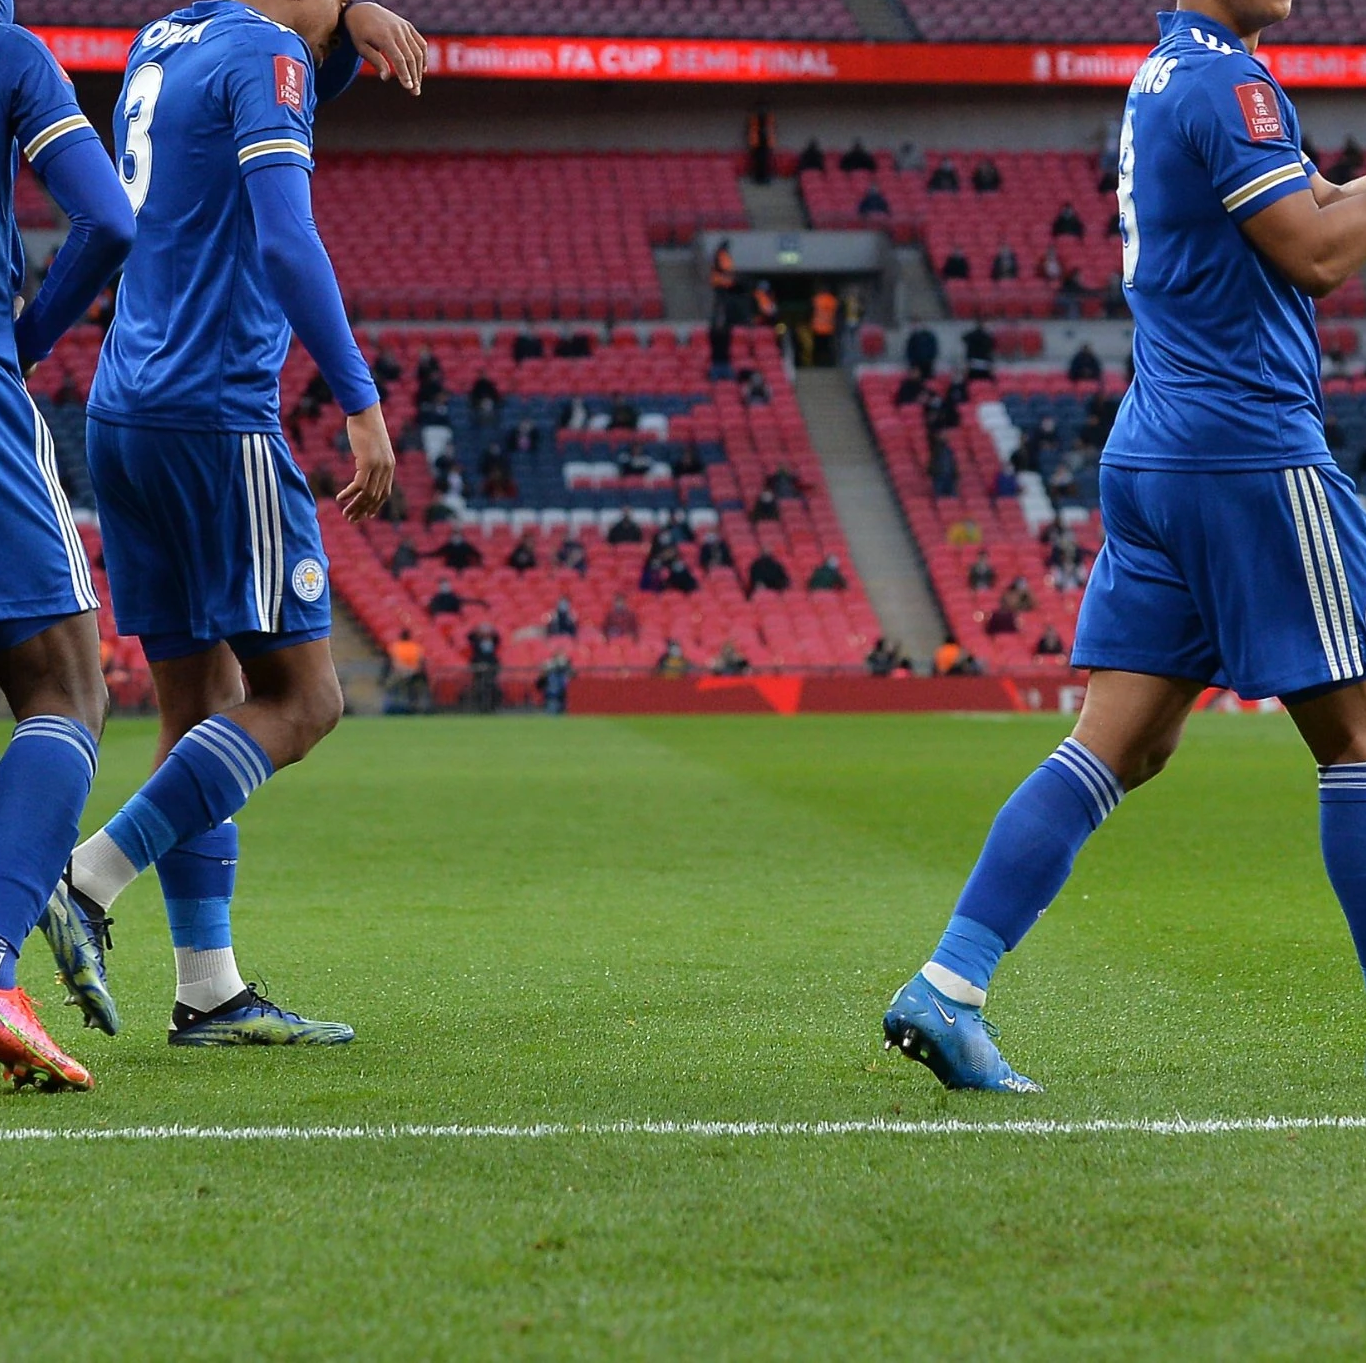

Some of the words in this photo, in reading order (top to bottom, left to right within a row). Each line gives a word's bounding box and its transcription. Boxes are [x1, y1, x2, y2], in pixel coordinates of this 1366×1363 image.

[446, 43, 553, 70] Emirates
[557, 45, 596, 70] FA
[600, 45, 662, 72] CUP
[669, 48, 837, 76] SEMI-FINAL
[119, 62, 163, 217] 3
[1254, 125, 1265, 134] FA
[1265, 123, 1279, 133] CUP
